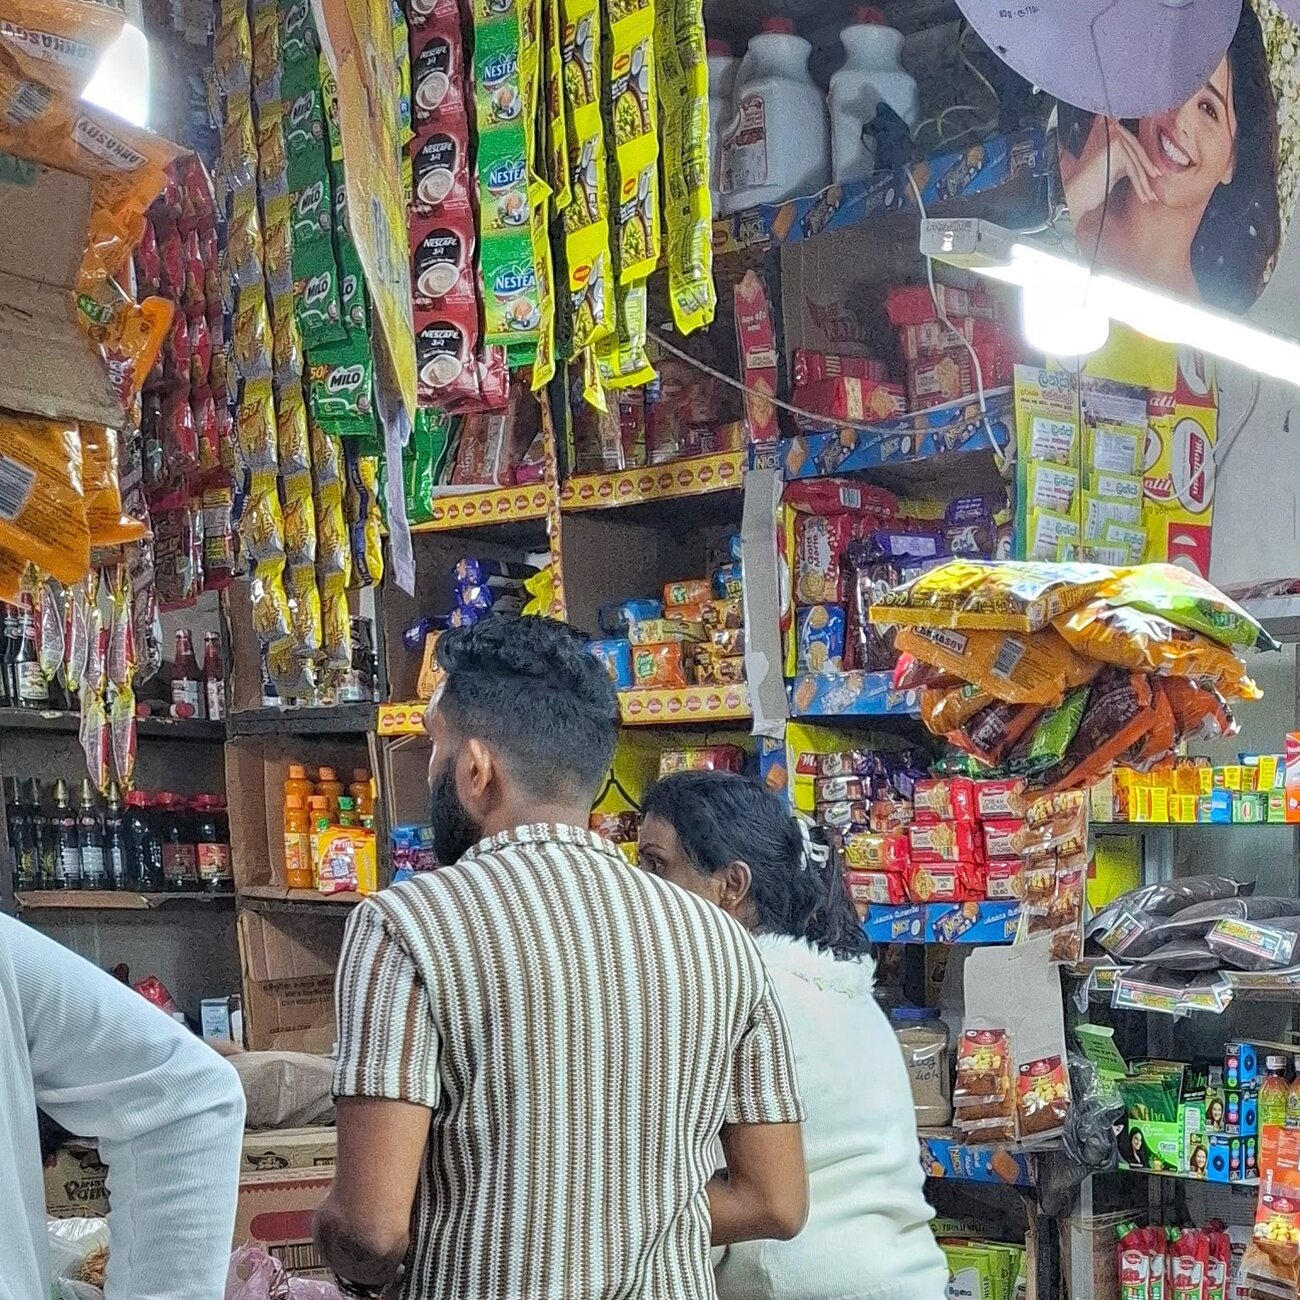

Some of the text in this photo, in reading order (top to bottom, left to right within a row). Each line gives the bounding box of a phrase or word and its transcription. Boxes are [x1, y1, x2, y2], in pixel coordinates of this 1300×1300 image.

[490, 169, 525, 184] NESTEA
[496, 275, 535, 289] NESTEA
[330, 371, 361, 387] MILO
